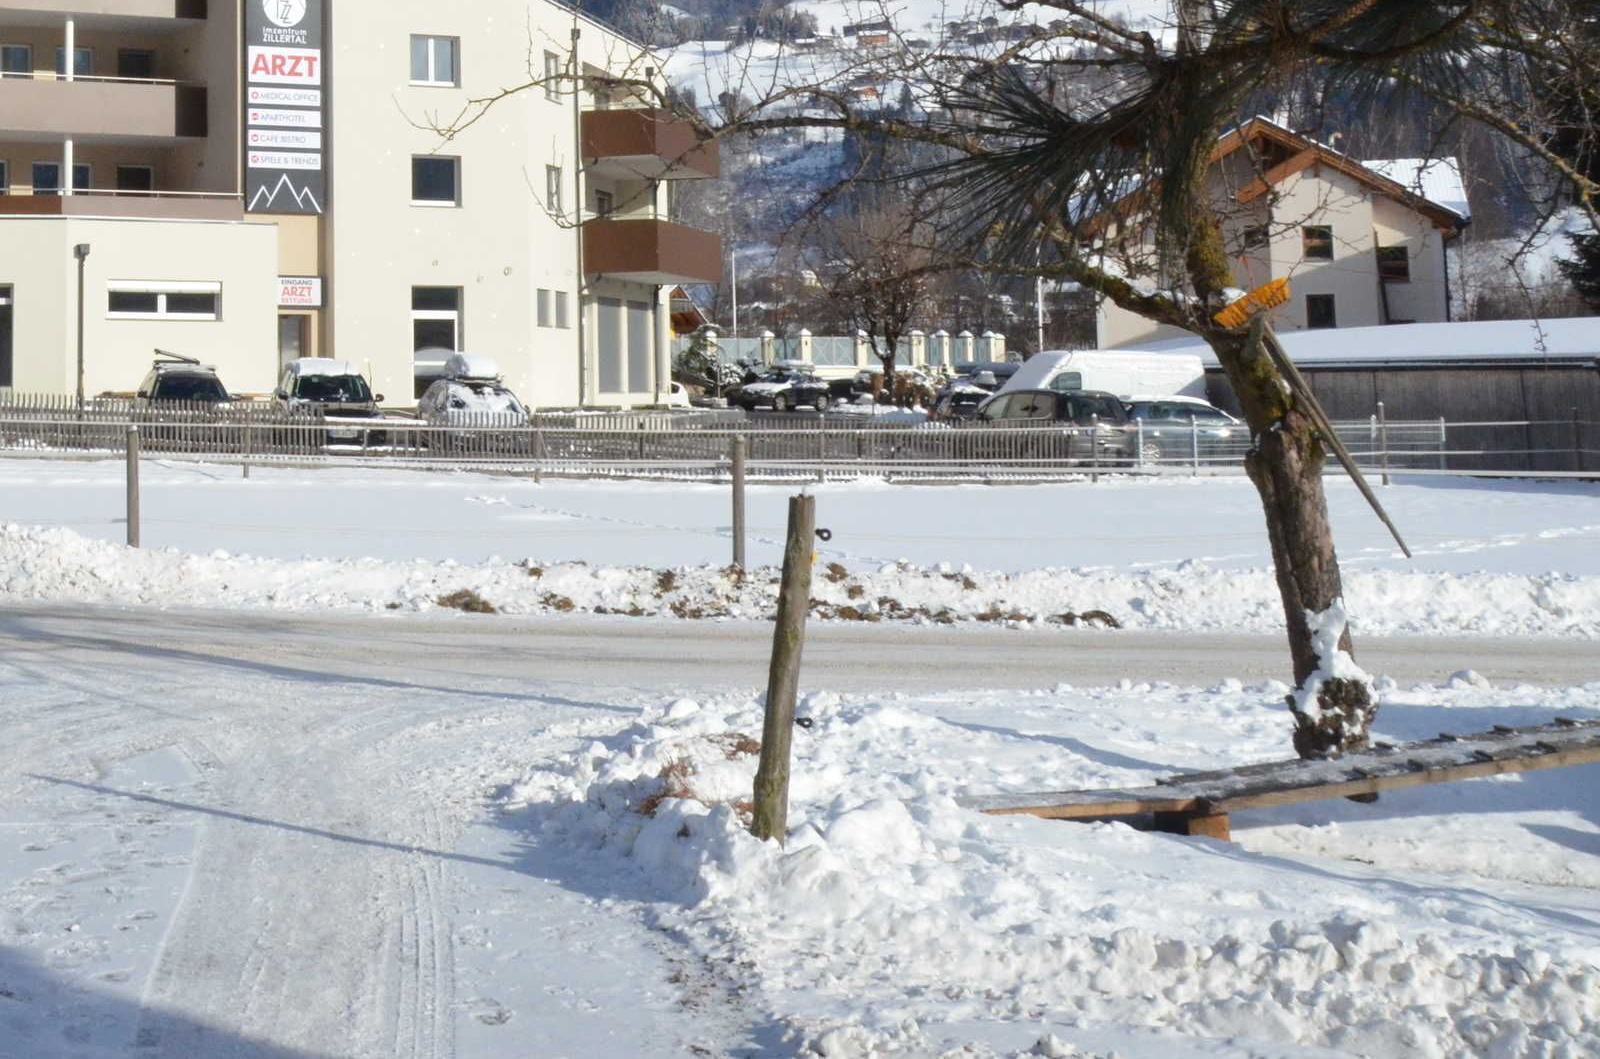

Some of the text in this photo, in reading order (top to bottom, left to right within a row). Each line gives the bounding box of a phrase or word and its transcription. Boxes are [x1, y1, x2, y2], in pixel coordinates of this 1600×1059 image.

[263, 34, 307, 44] ZILLERTAL
[252, 54, 318, 77] ARZT
[260, 92, 318, 102] MEDICAL OFFICE
[261, 114, 306, 123] APARTHOTEL
[280, 135, 306, 144] BISTRO
[261, 156, 281, 164] SPIELE
[291, 156, 319, 165] TRENDS
[281, 286, 312, 297] ARZT
